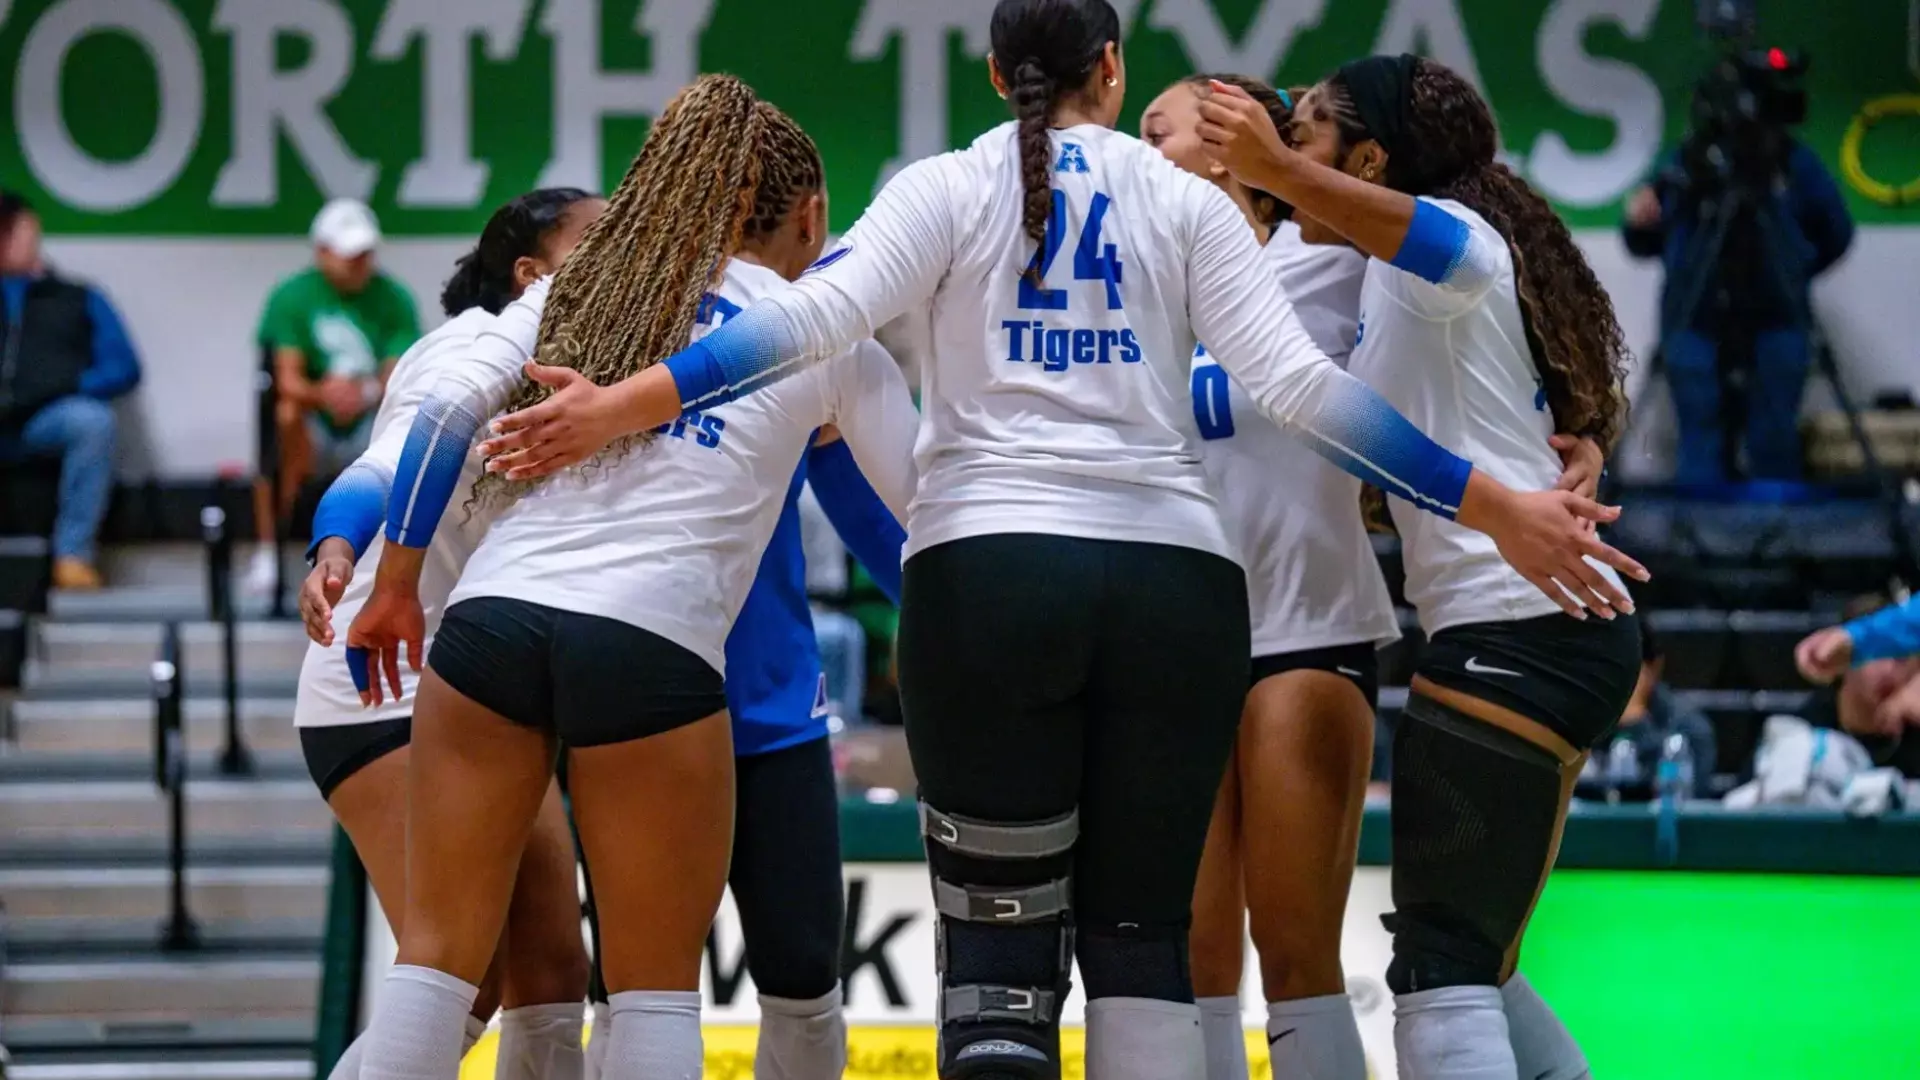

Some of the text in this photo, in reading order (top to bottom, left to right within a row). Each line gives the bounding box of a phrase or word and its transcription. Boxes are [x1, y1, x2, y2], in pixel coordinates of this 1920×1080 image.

[0, 0, 716, 214] ORTH
[1018, 189, 1123, 310] 24
[1002, 320, 1142, 372] Tigers
